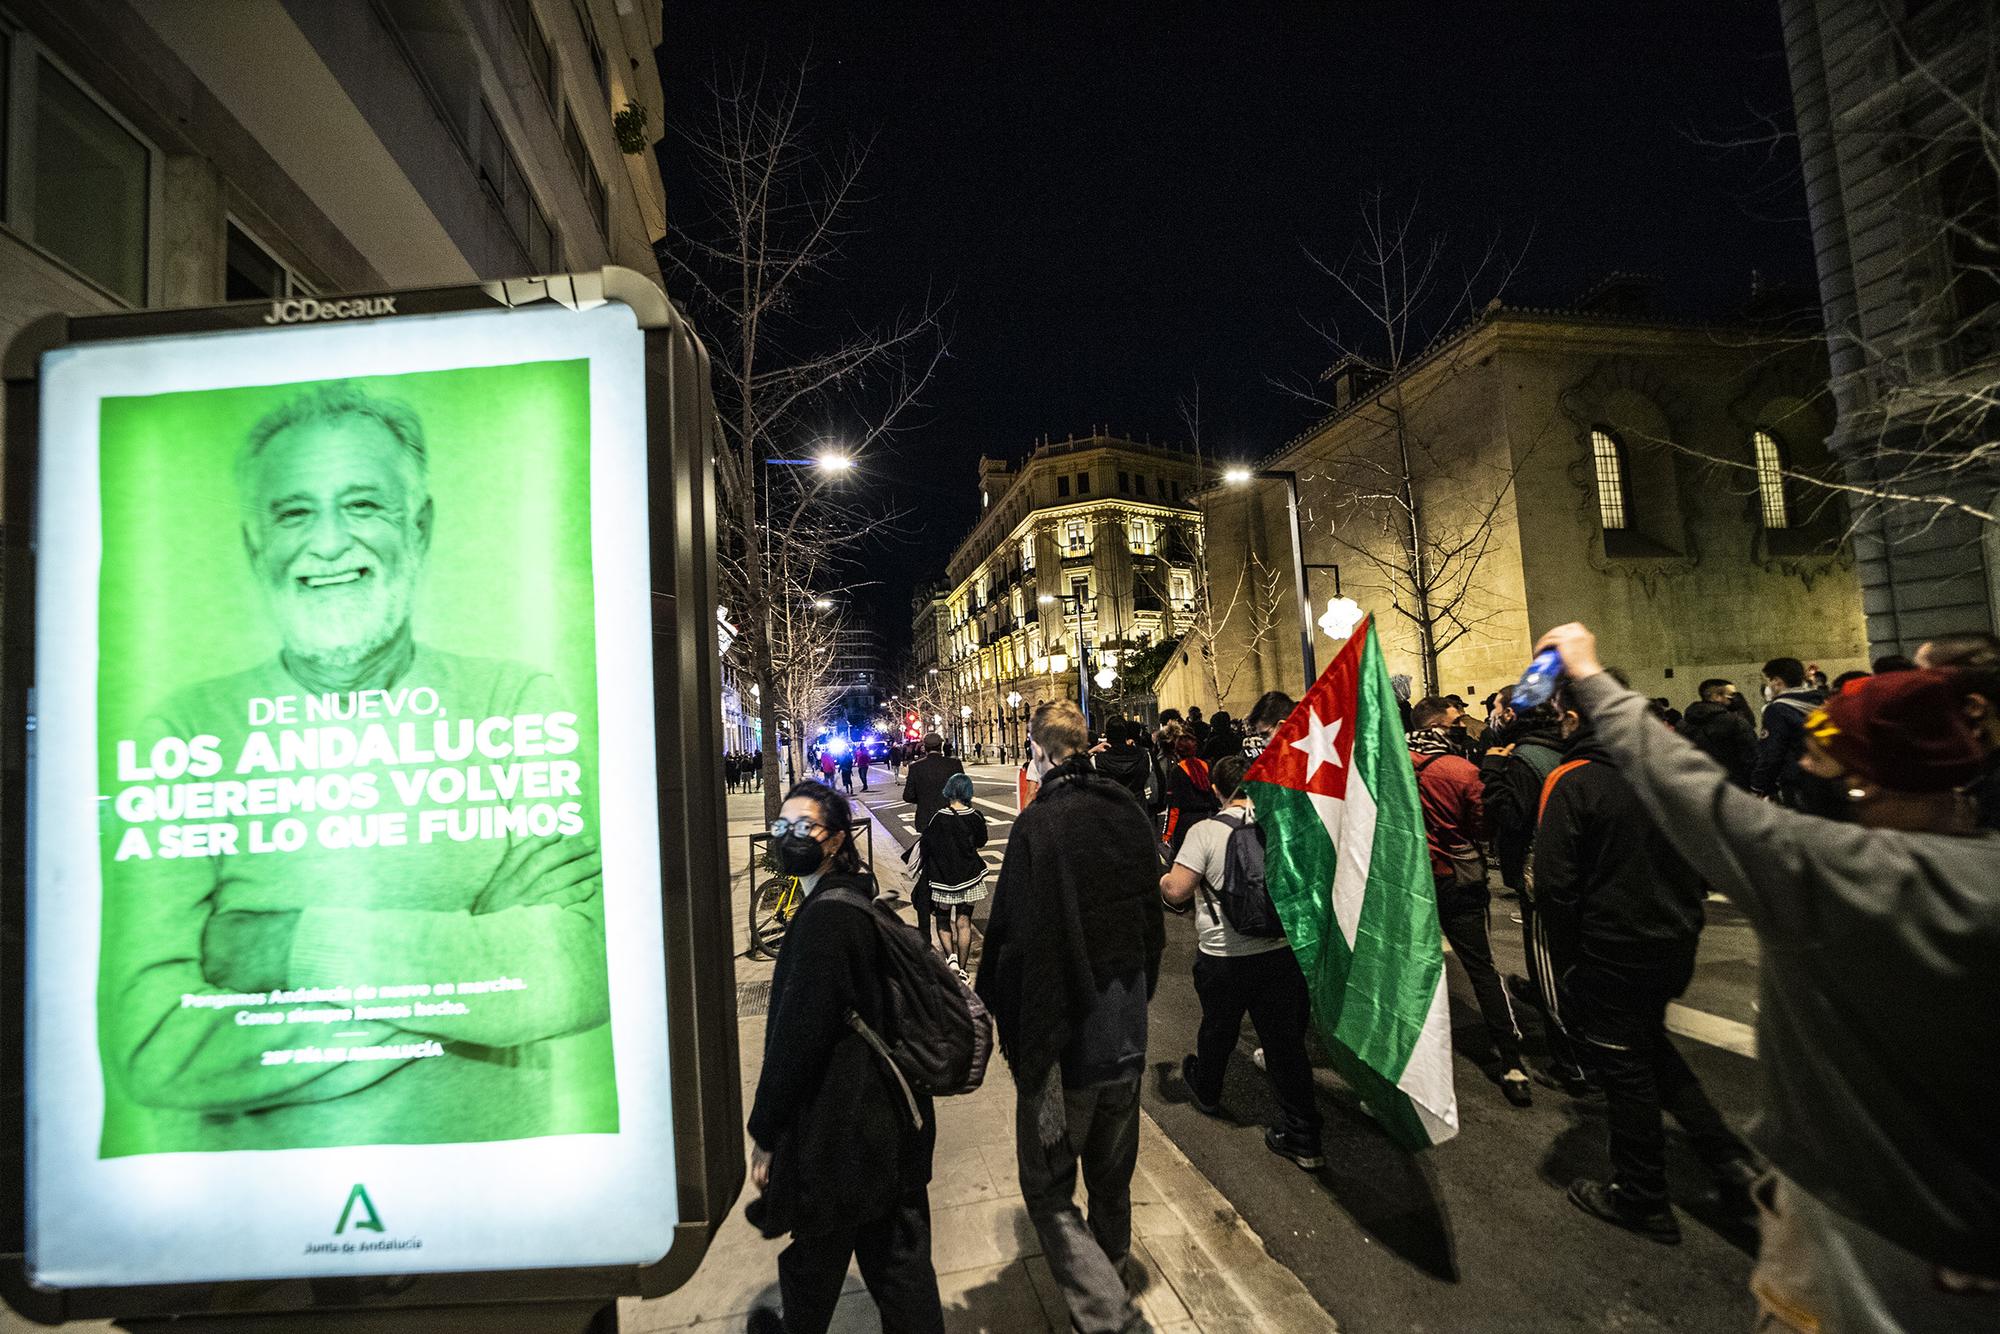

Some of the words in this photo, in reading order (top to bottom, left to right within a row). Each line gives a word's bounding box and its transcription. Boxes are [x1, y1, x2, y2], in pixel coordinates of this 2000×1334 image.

[265, 298, 397, 325] JCDecaux
[248, 695, 299, 726] DE
[305, 686, 447, 722] NUEVO,
[116, 734, 223, 782] LOS
[235, 711, 580, 774] ANDALUCES
[114, 772, 380, 823] QUEREMOS
[389, 760, 582, 807] VOLVER
[114, 827, 152, 862] A
[157, 822, 239, 860] SER
[248, 818, 309, 854] LO
[316, 812, 408, 850] QUE
[418, 801, 584, 844] FUIMOS
[234, 1010, 286, 1026] Como
